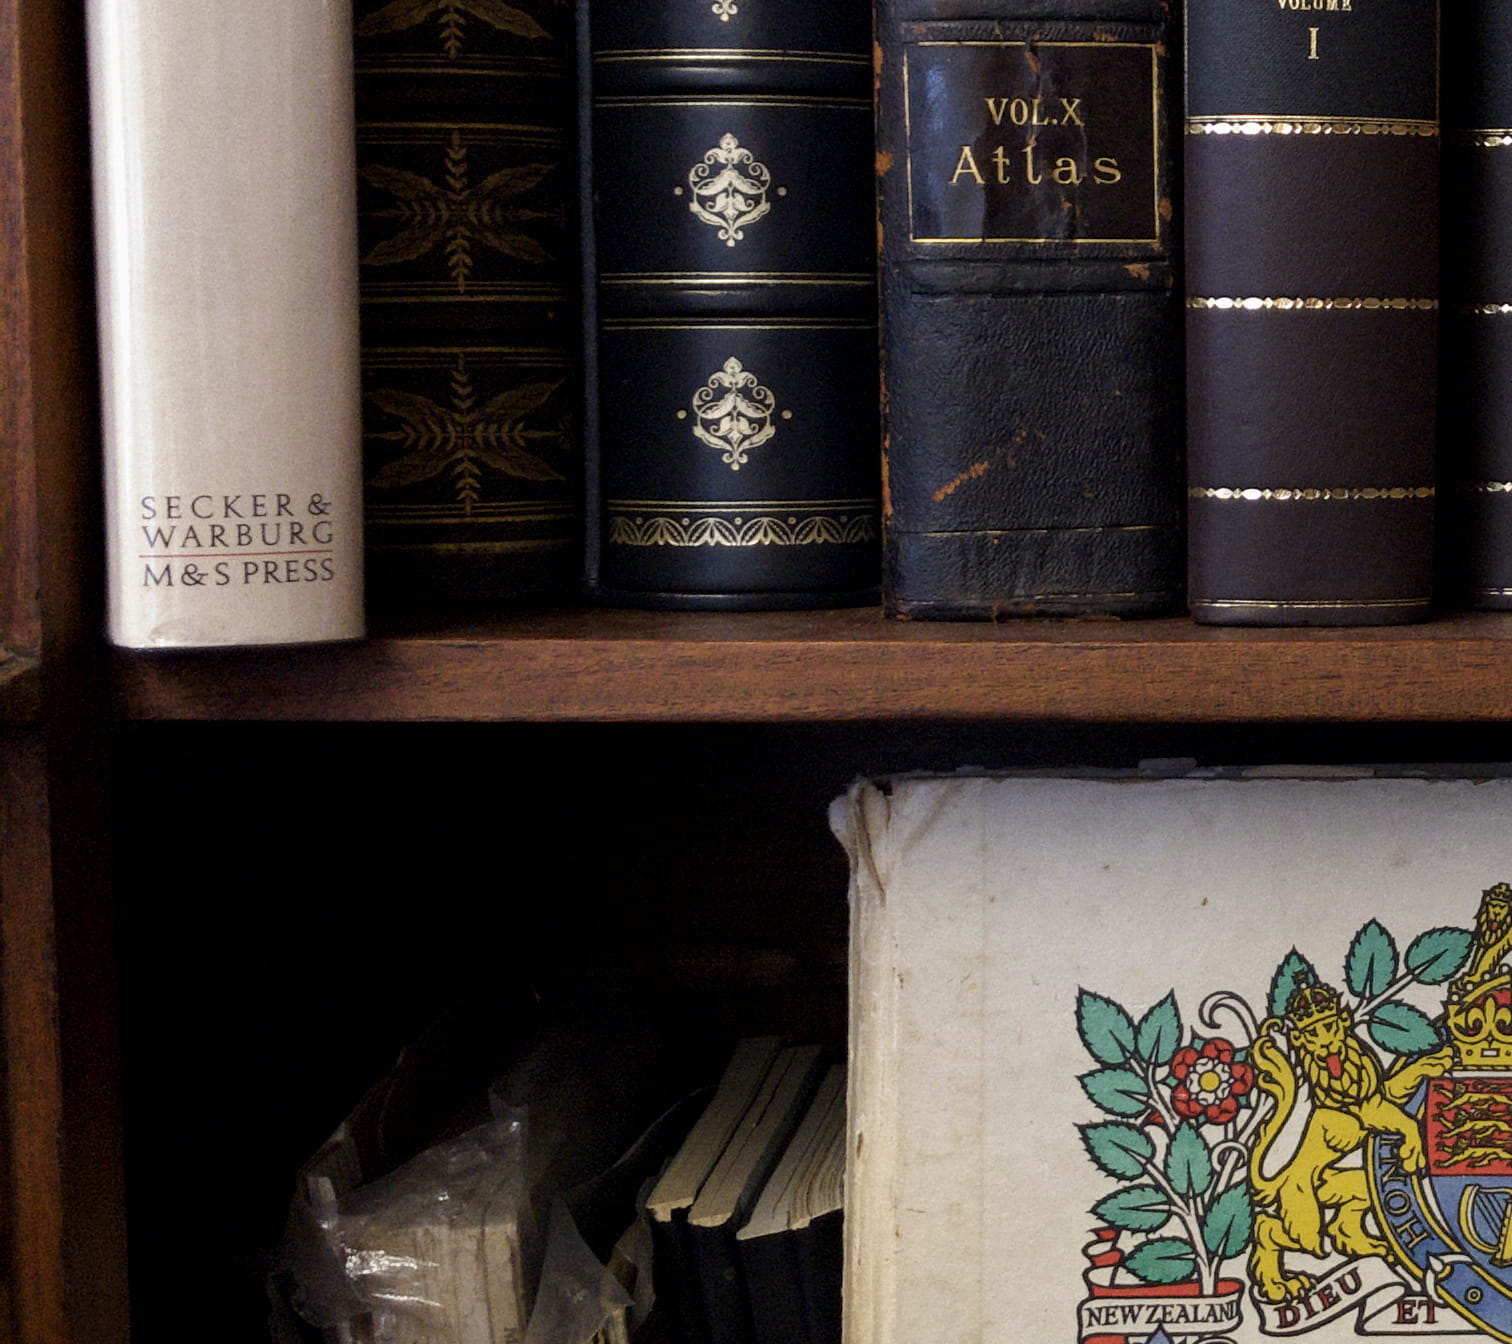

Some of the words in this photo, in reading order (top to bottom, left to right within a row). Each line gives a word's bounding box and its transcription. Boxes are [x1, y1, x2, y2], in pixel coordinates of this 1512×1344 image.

[1307, 26, 1321, 61] I
[948, 144, 1123, 186] Atlas
[140, 492, 296, 520] SECKER
[307, 491, 332, 517] &
[141, 520, 334, 549] WARBURG
[143, 562, 175, 588] M
[180, 562, 209, 587] &
[215, 561, 231, 586] S
[242, 557, 336, 585] PRESS
[1276, 1268, 1365, 1331] DIEU
[1392, 1298, 1438, 1325] ET
[1084, 1304, 1145, 1328] NEW
